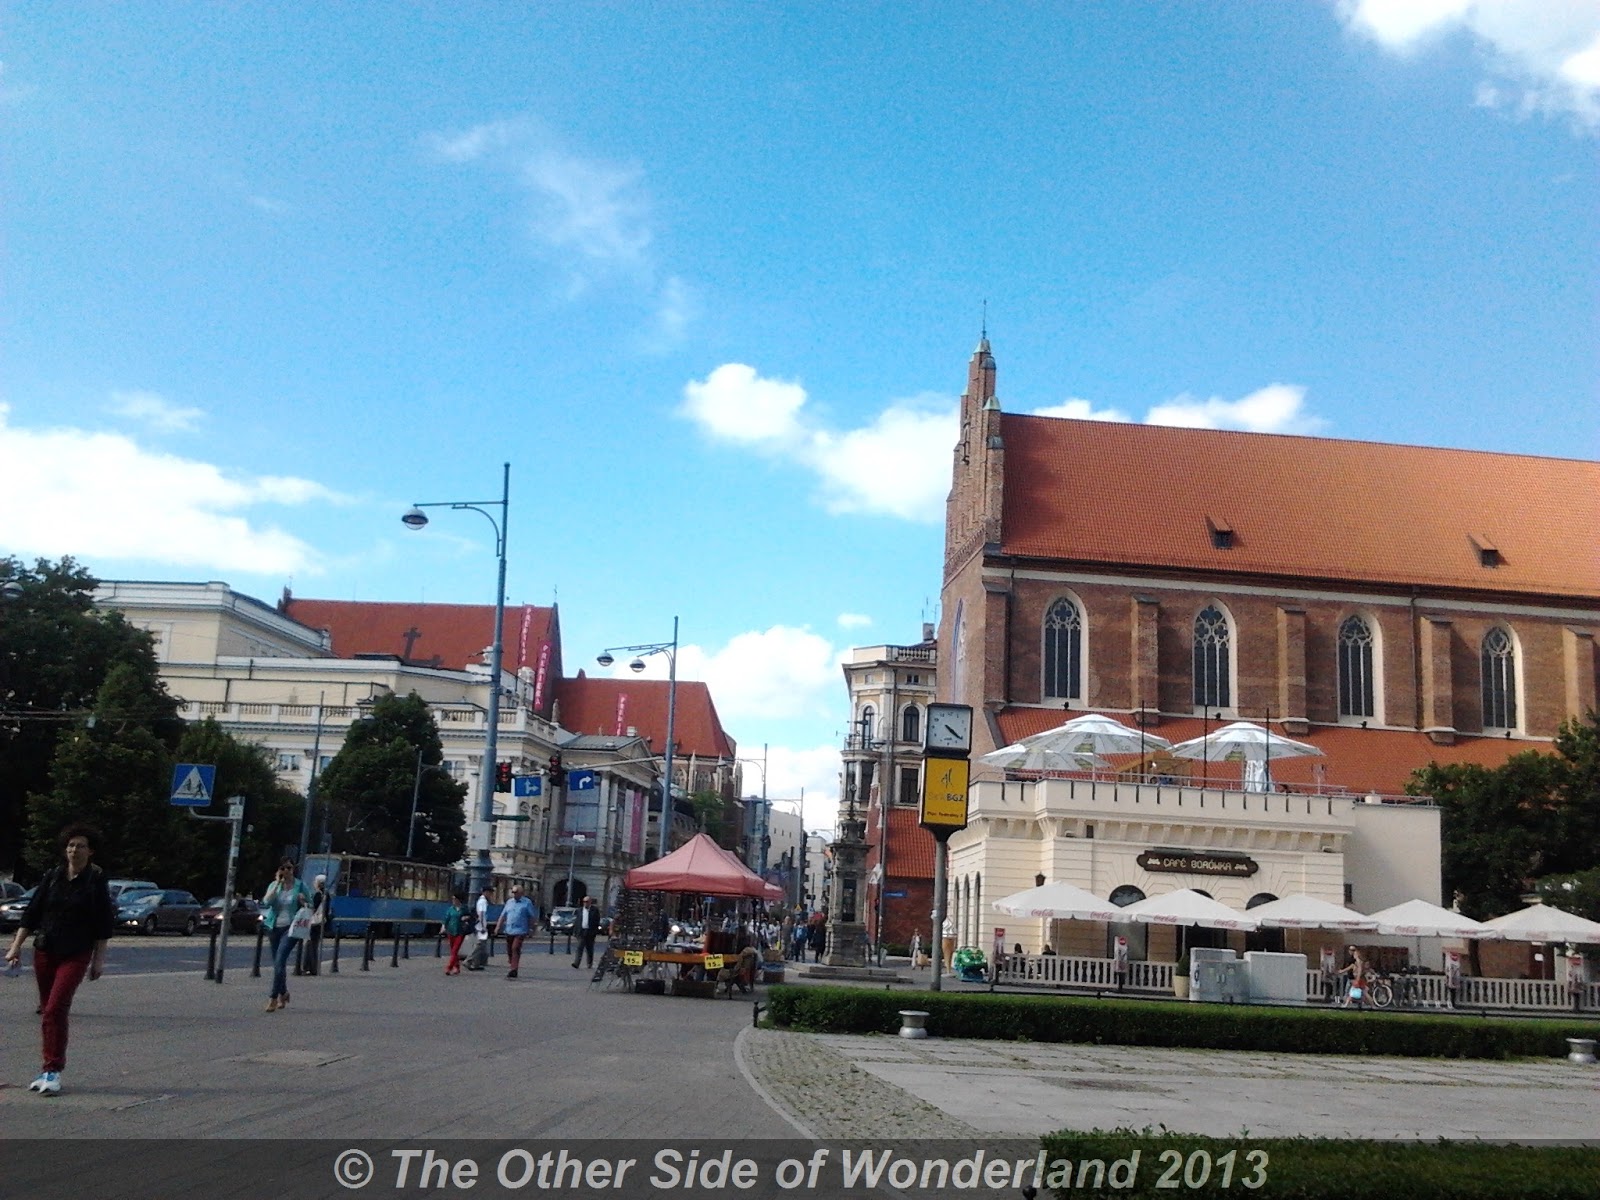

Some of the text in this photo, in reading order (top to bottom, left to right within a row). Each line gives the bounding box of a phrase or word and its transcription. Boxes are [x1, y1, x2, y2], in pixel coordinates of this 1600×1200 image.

[535, 644, 549, 705] PREMIERA
[1163, 857, 1232, 871] CAFÉ BORÓWKA
